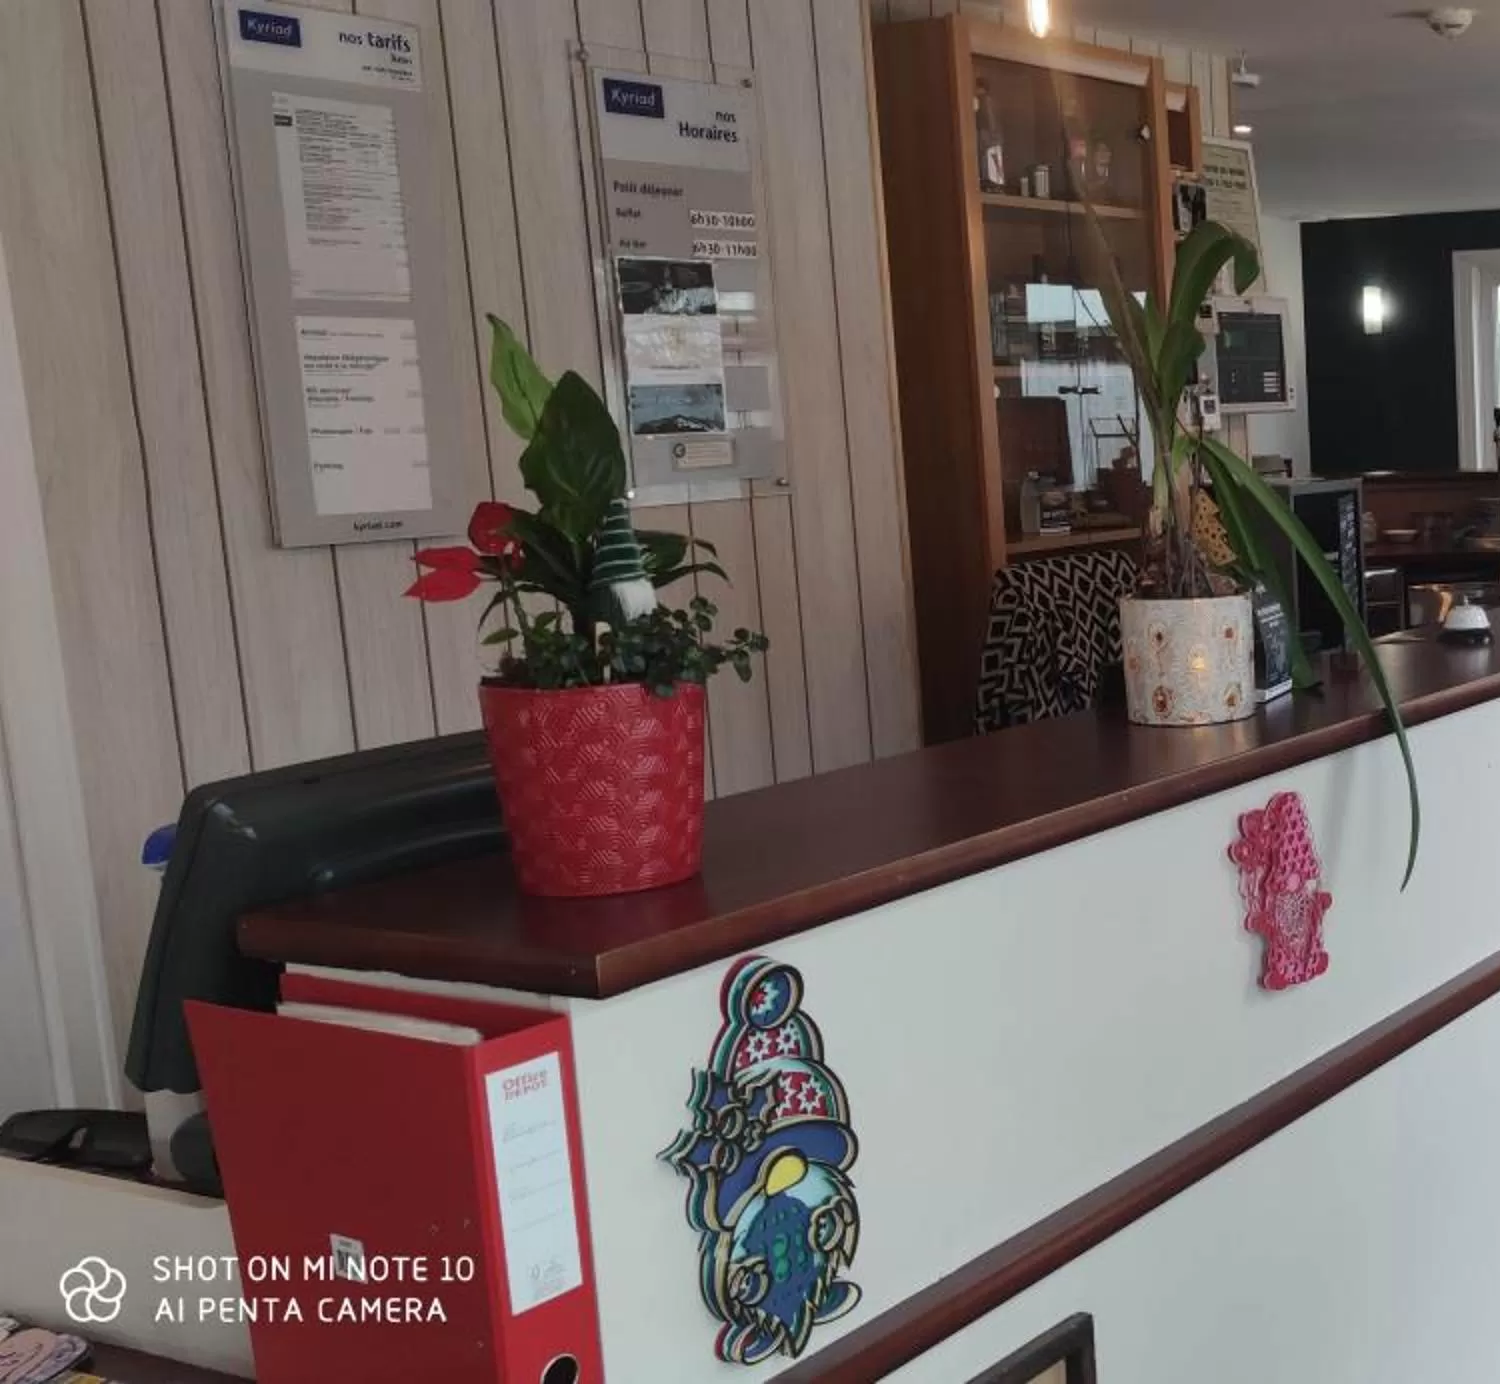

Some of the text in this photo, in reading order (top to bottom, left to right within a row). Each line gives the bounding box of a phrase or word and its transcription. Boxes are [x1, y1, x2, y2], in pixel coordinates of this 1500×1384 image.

[247, 17, 292, 38] Kyriad
[338, 30, 411, 53] nos tarifs
[611, 88, 656, 107] Kyriad
[715, 110, 737, 123] nos
[679, 120, 739, 143] Horaires
